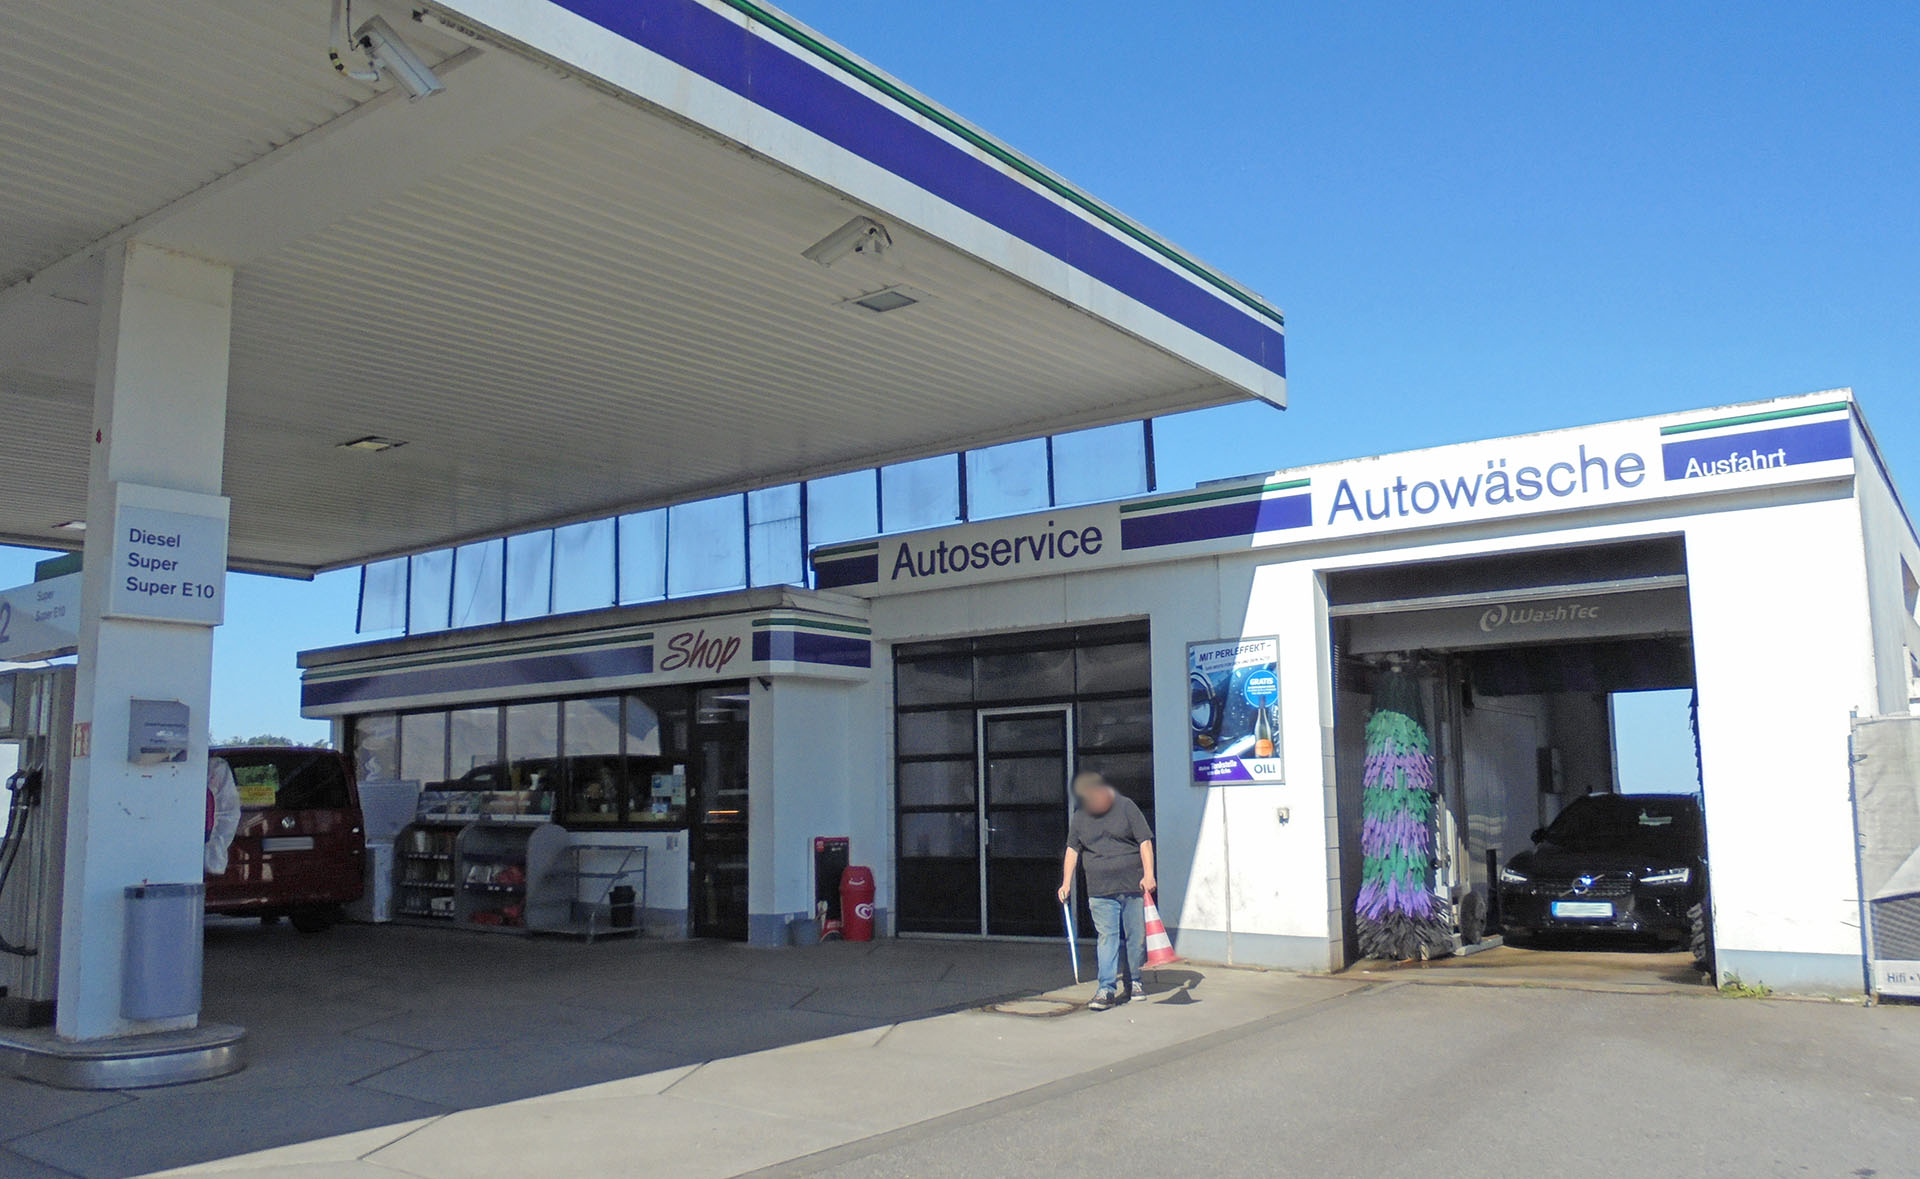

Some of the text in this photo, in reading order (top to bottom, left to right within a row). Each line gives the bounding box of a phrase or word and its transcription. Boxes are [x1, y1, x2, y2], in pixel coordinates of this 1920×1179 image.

[1684, 447, 1787, 480] Ausfahrt
[1328, 444, 1645, 525] Autowäsche
[129, 528, 181, 547] Diesel
[891, 520, 1103, 580] Autoservice
[128, 552, 178, 572] Super
[37, 589, 55, 602] Super
[126, 576, 215, 599] Super E10
[34, 610, 53, 623] Super
[1509, 604, 1600, 624] WashTec
[660, 629, 741, 673] Shop
[1199, 651, 1214, 662] MIT
[1249, 677, 1274, 686] GRATIS
[1253, 763, 1276, 774] OIL!
[1886, 972, 1906, 983] Hifi
